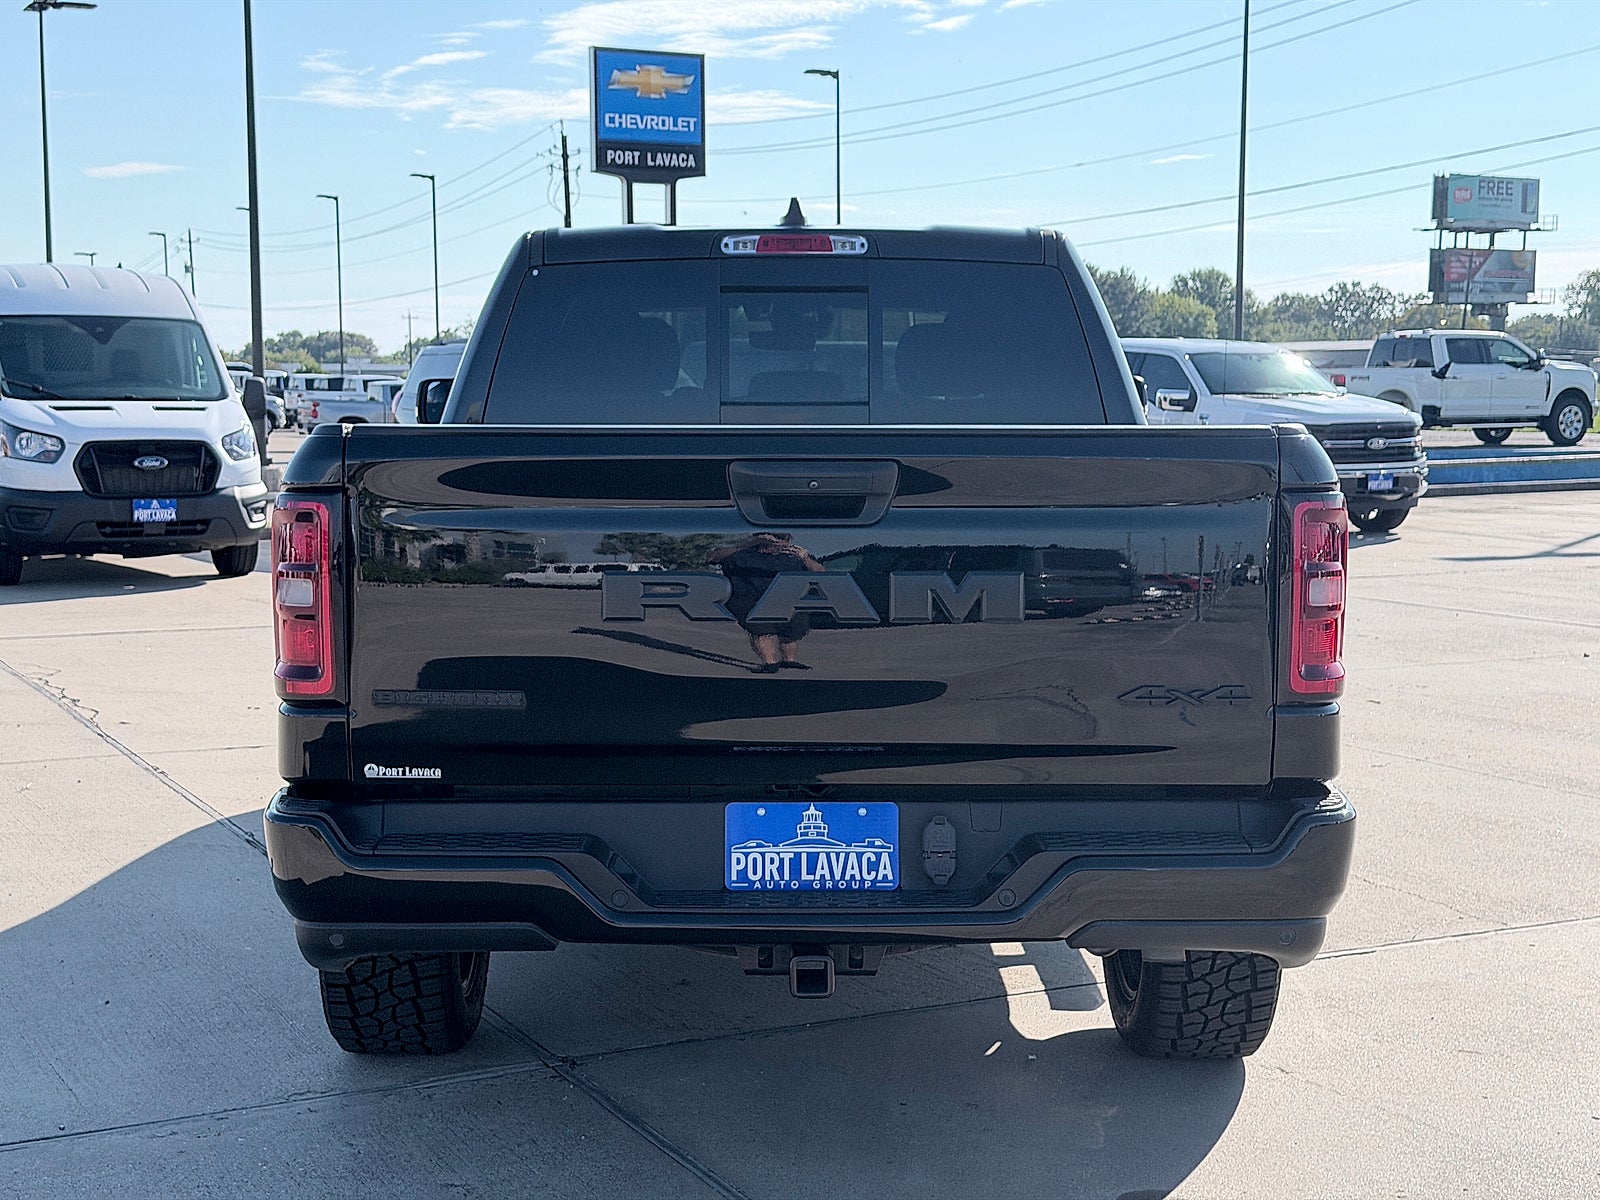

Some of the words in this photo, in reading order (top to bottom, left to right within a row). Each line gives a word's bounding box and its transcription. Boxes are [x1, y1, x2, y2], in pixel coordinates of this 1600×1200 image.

[604, 112, 698, 133] CHEVROLET
[606, 149, 641, 166] PORT
[646, 151, 696, 168] LAVACA
[1478, 178, 1514, 196] FREE
[601, 570, 1026, 624] RAM
[731, 851, 795, 881] PORT
[801, 851, 894, 881] LAVACA
[753, 880, 799, 889] AUTO
[812, 880, 873, 889] GROUP
